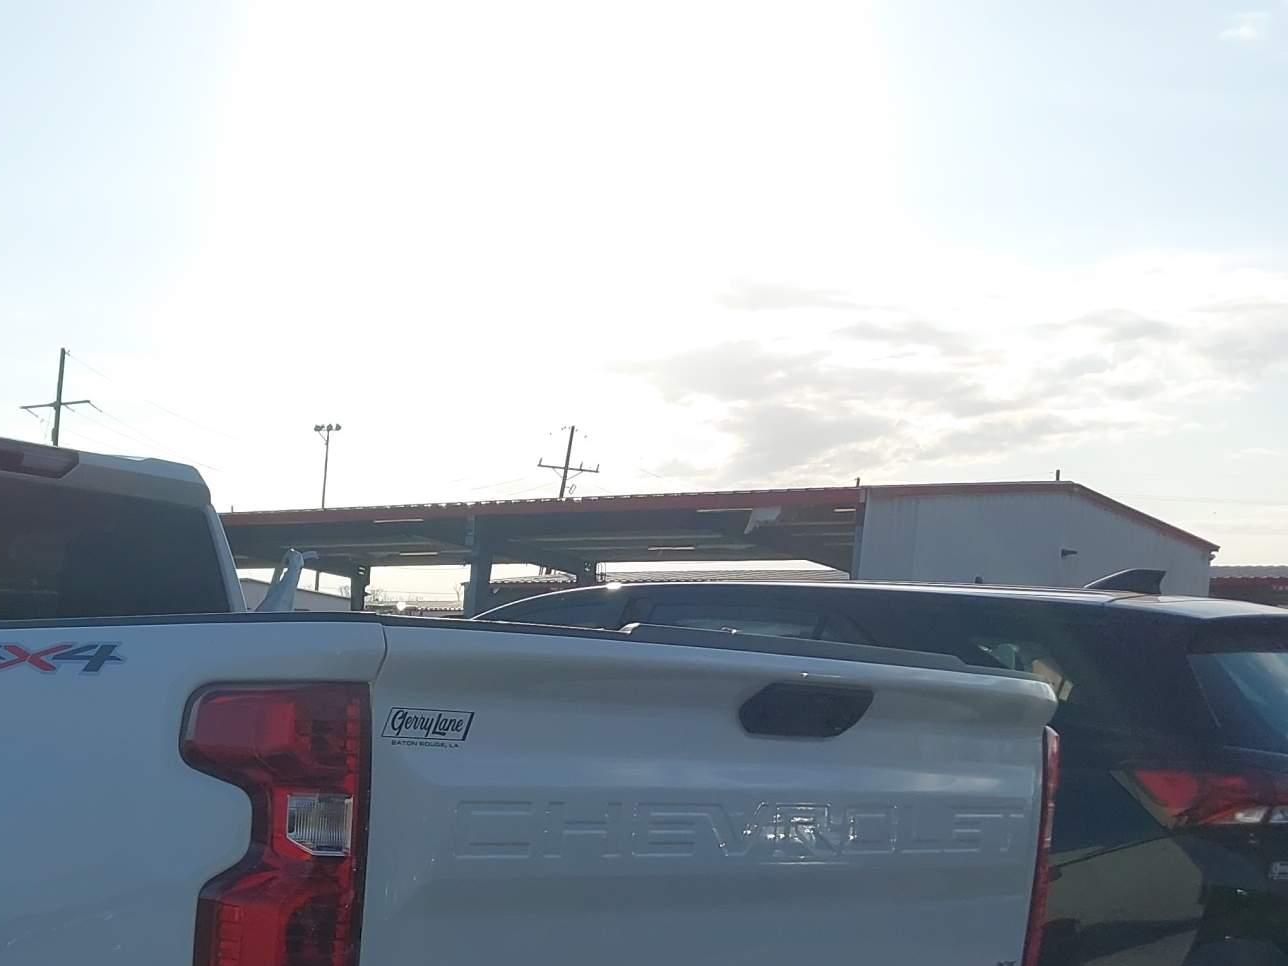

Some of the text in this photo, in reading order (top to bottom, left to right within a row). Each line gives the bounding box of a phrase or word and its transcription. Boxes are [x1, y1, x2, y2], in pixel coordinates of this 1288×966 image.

[391, 709, 464, 737] Gerry Lane
[452, 800, 1025, 860] CHEVROLET
